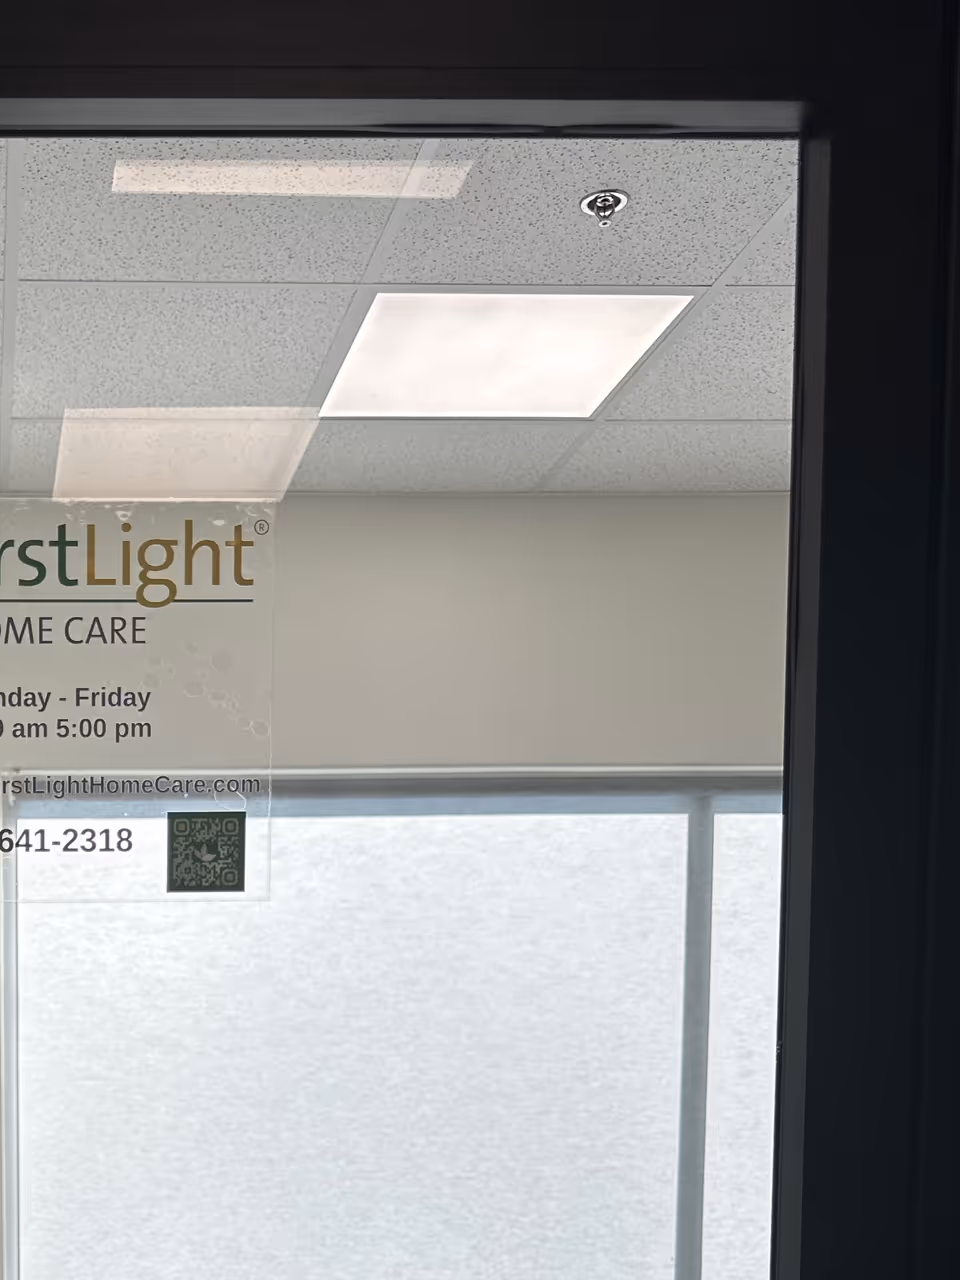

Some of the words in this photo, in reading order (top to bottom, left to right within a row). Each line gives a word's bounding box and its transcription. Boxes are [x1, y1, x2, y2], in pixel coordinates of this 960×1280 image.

[63, 616, 147, 645] CARE
[74, 687, 151, 712] Friday
[11, 723, 48, 738] am
[55, 718, 107, 738] 5:00
[114, 723, 152, 743] pm
